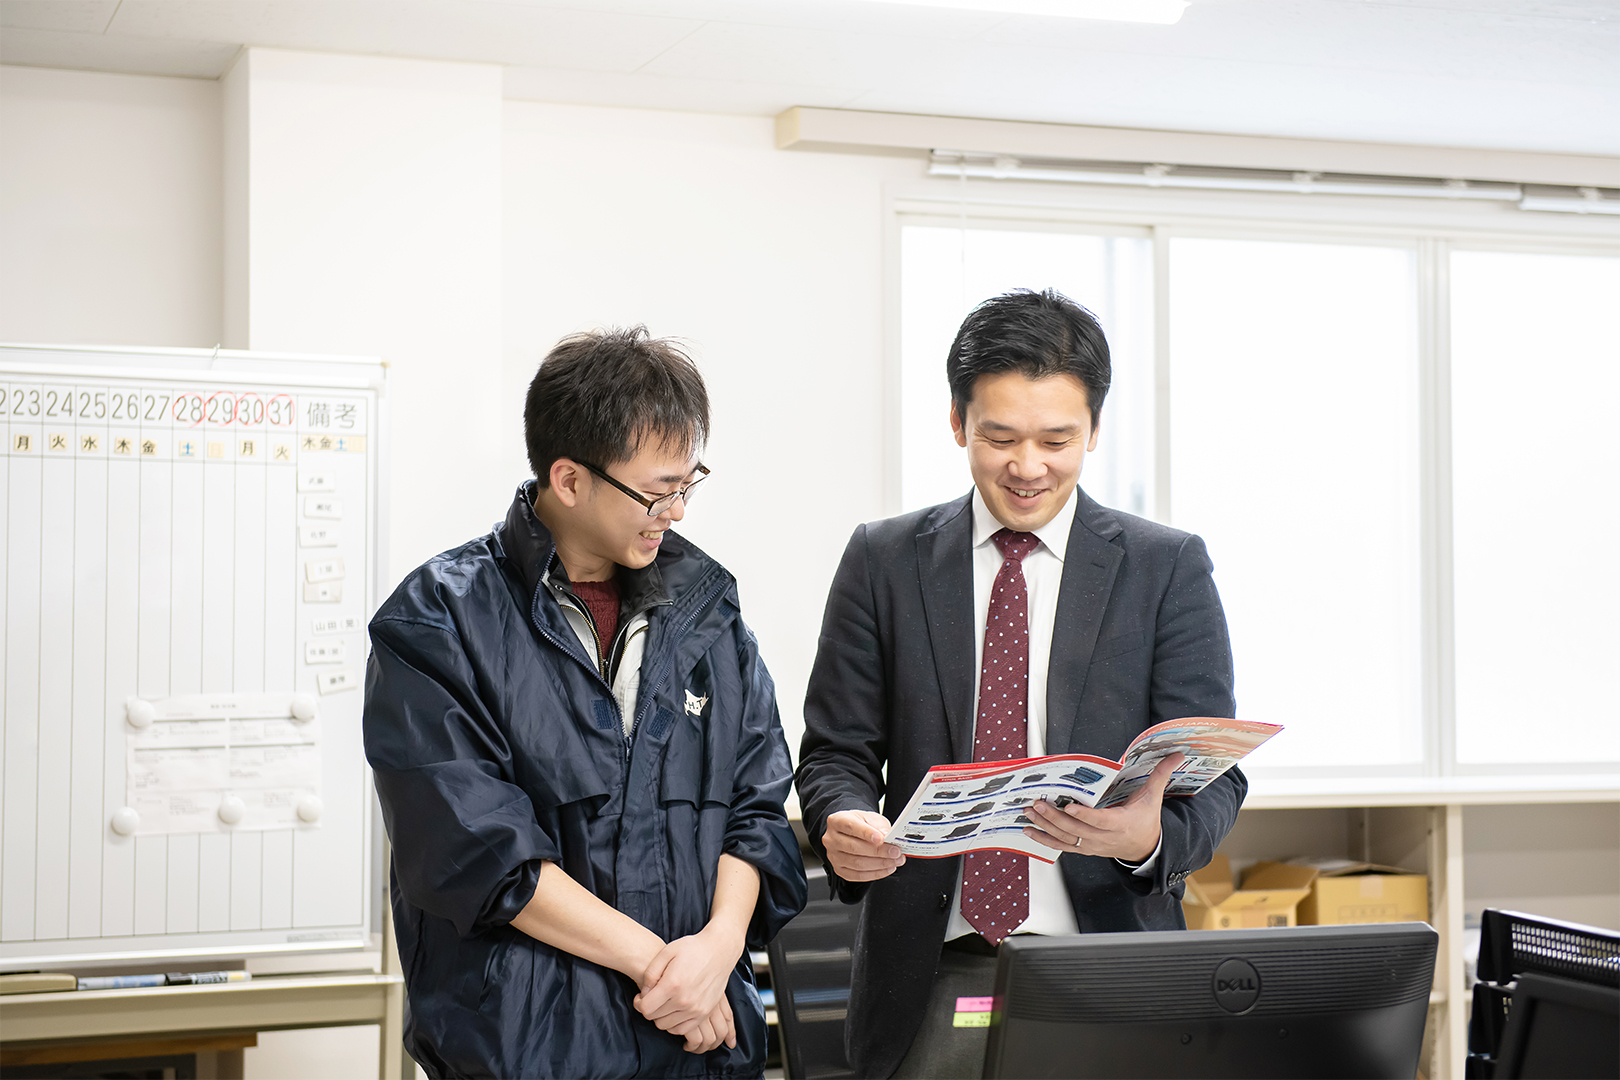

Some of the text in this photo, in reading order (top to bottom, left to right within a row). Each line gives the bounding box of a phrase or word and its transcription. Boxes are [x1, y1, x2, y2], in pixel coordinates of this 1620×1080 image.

[13, 389, 41, 416] 23
[46, 391, 73, 417] 24
[79, 392, 106, 419] 25
[112, 393, 139, 419] 26
[144, 394, 170, 421] 27
[175, 396, 203, 423] 28
[208, 397, 233, 424] 29
[238, 399, 264, 425] 30
[269, 400, 293, 425] 31
[307, 401, 358, 429] 備考
[17, 435, 29, 450] 月
[52, 435, 66, 449] 火
[83, 436, 98, 450] 水
[116, 439, 131, 453] 木
[142, 440, 156, 454] 金
[181, 441, 195, 456] 土
[242, 442, 253, 455] 月
[275, 446, 289, 459] 火
[1217, 978, 1256, 992] DELL
